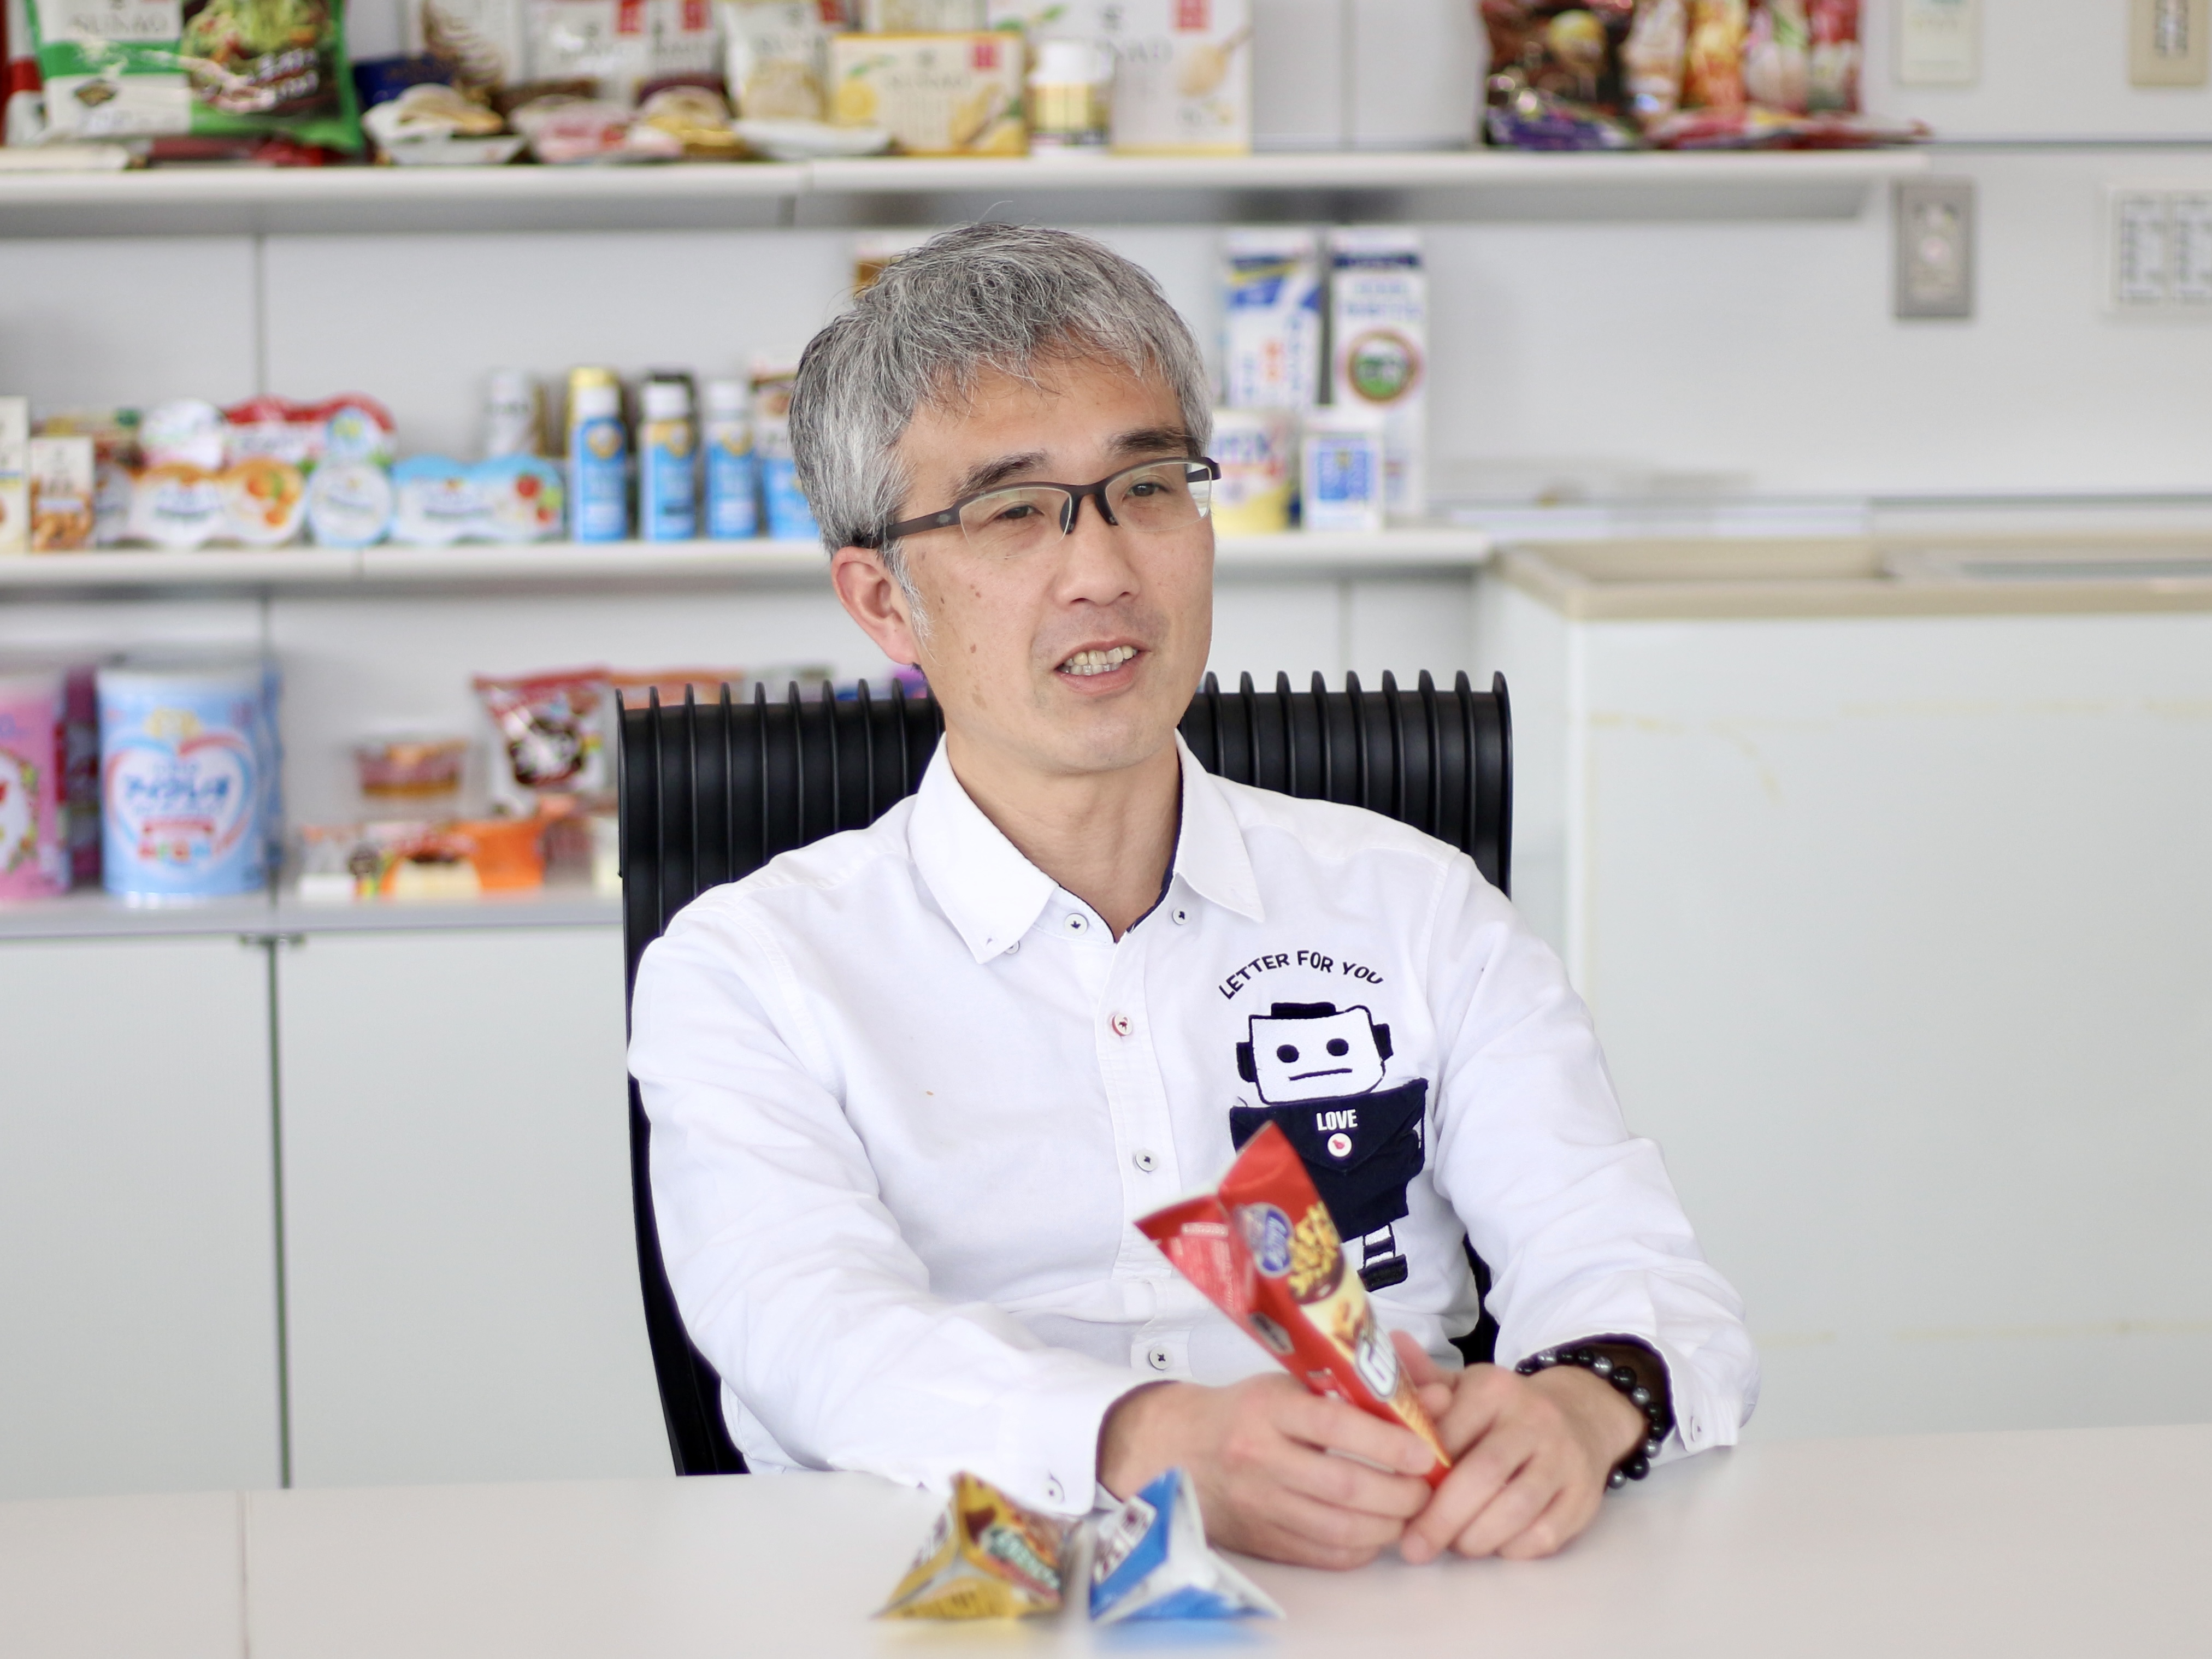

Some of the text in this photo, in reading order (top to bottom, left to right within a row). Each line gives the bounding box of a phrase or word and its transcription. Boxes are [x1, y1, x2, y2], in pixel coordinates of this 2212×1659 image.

[1218, 950, 1384, 1000] LETTER FOR YOU
[1316, 1109, 1358, 1131] LOVE
